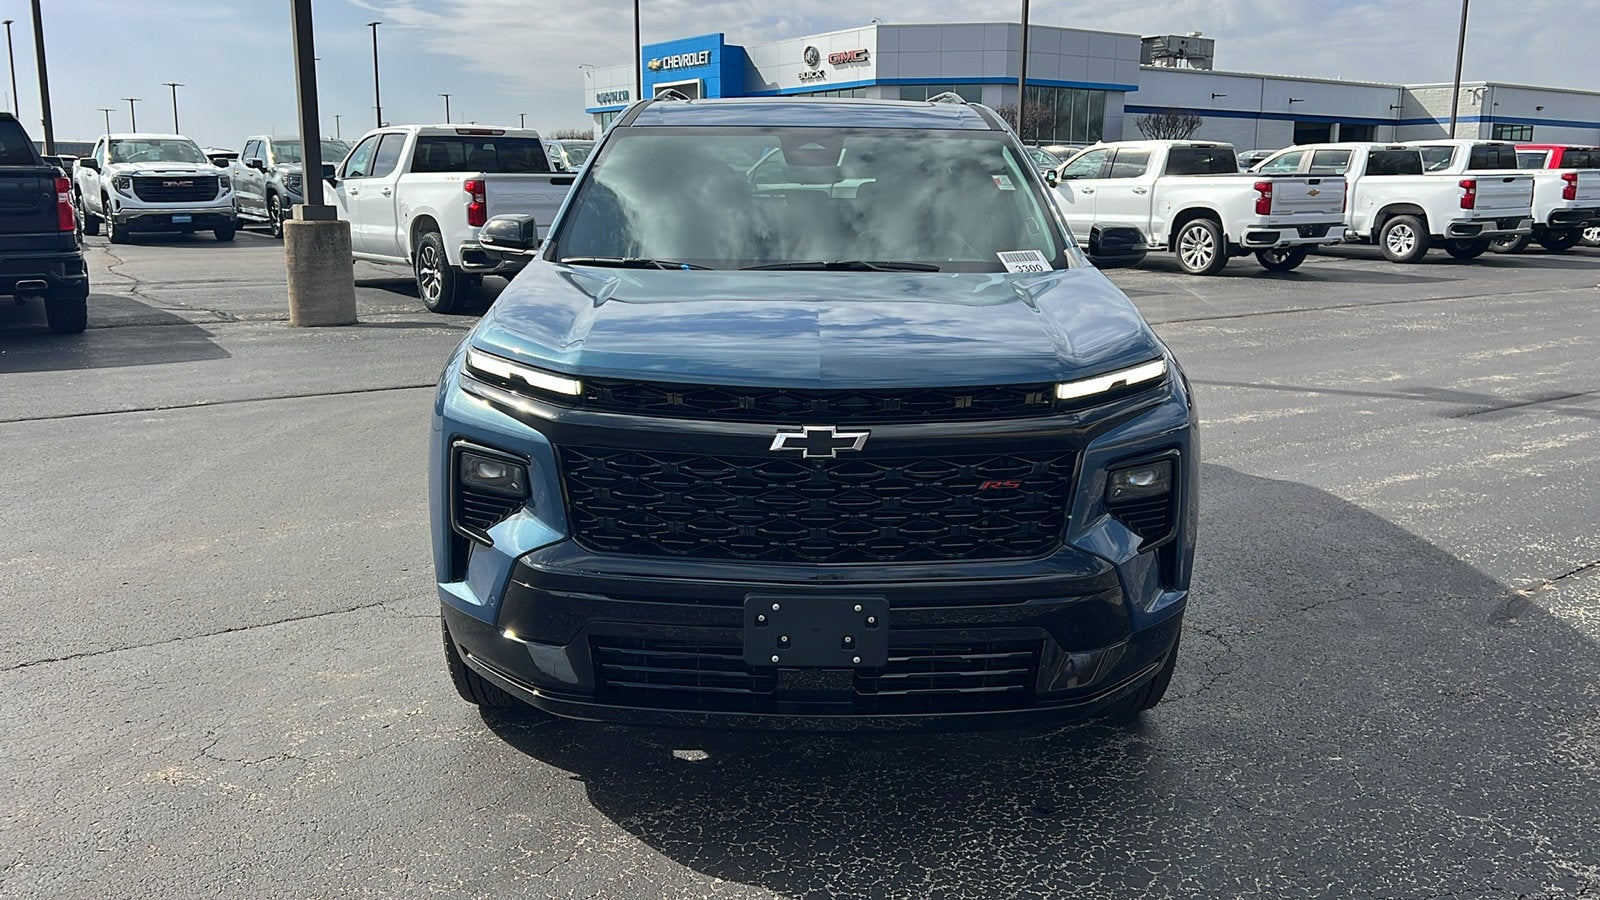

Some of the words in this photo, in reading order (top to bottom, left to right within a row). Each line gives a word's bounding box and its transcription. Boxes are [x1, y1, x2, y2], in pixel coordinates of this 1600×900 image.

[663, 50, 711, 70] CHEVROLET
[828, 49, 868, 65] GMC
[798, 69, 826, 80] BUICK
[162, 180, 194, 188] GMC
[1015, 264, 1044, 273] 3300
[978, 480, 1021, 490] RS
